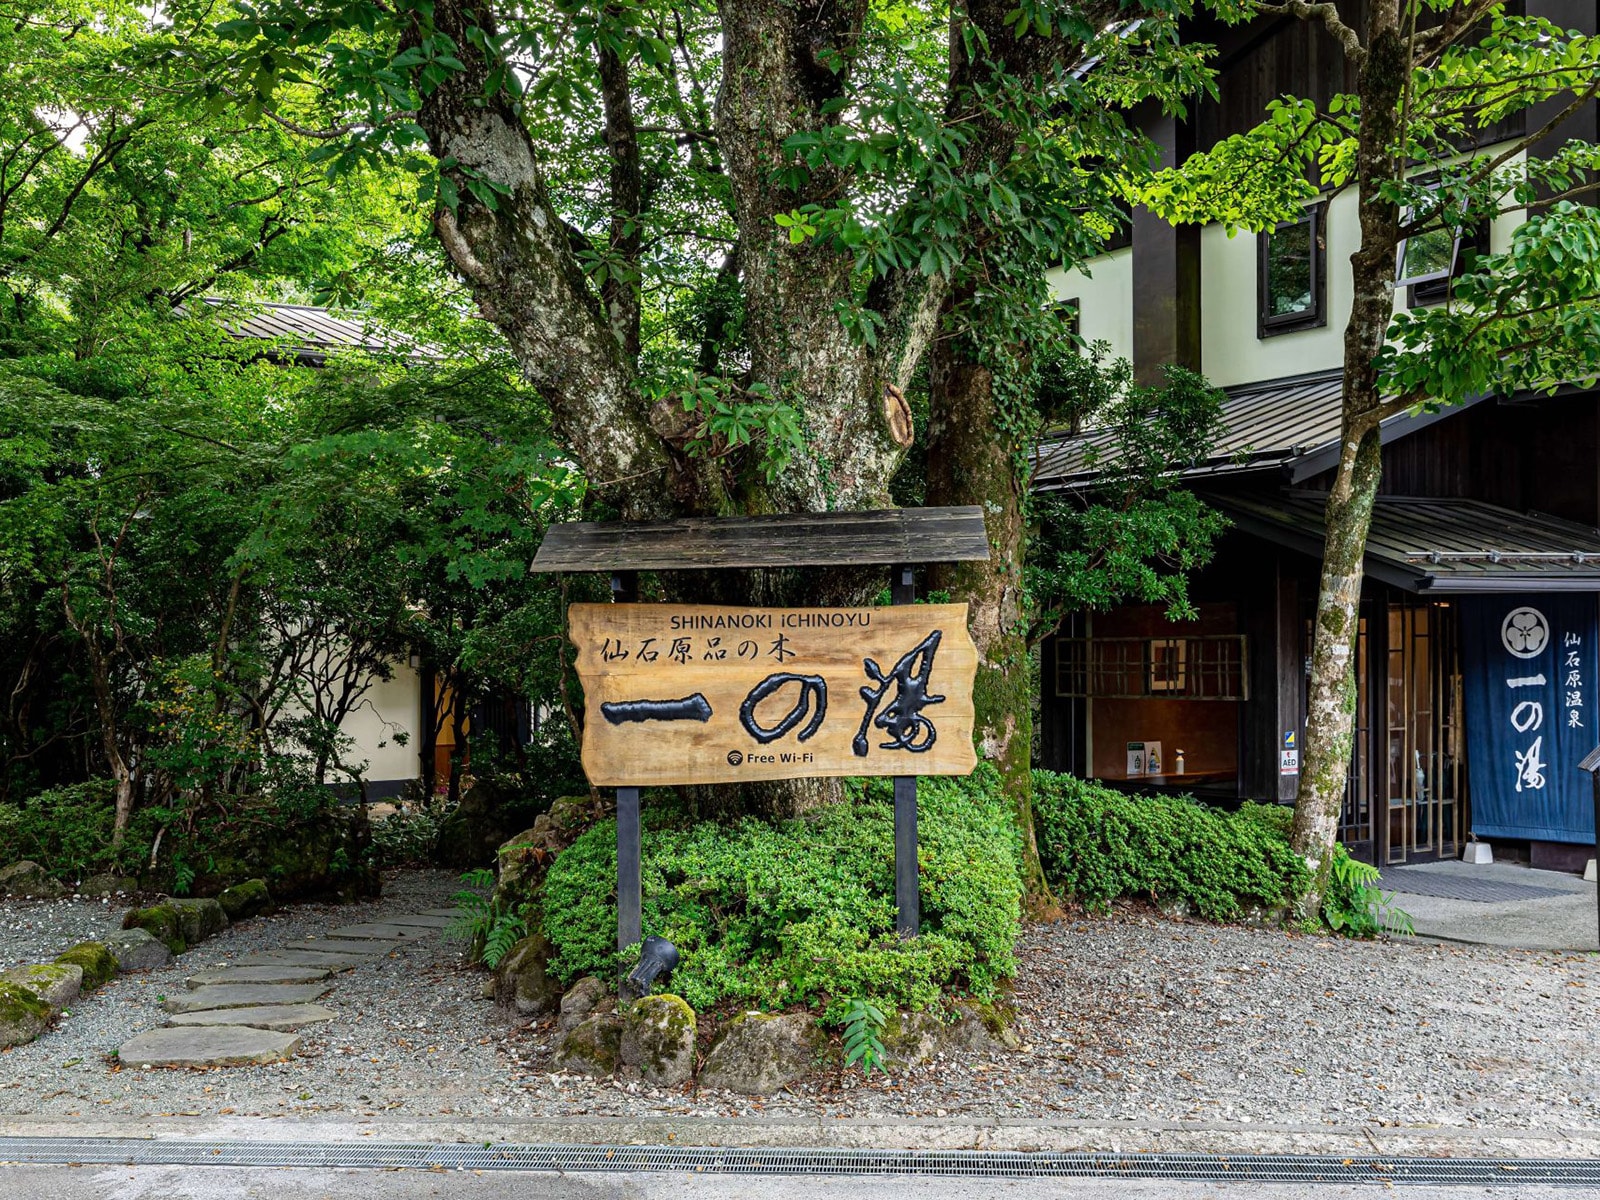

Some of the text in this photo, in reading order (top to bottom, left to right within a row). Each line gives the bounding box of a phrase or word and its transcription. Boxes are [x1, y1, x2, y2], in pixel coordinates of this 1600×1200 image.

[670, 614, 772, 630] SHINANOKI
[600, 632, 796, 665] 仙石原品の木
[601, 630, 946, 757] 一の湯
[1564, 631, 1584, 729] 仙石原温泉
[1506, 673, 1547, 792] 一の湯
[747, 752, 813, 763] Free Wi-Fi
[1283, 758, 1296, 767] AED
